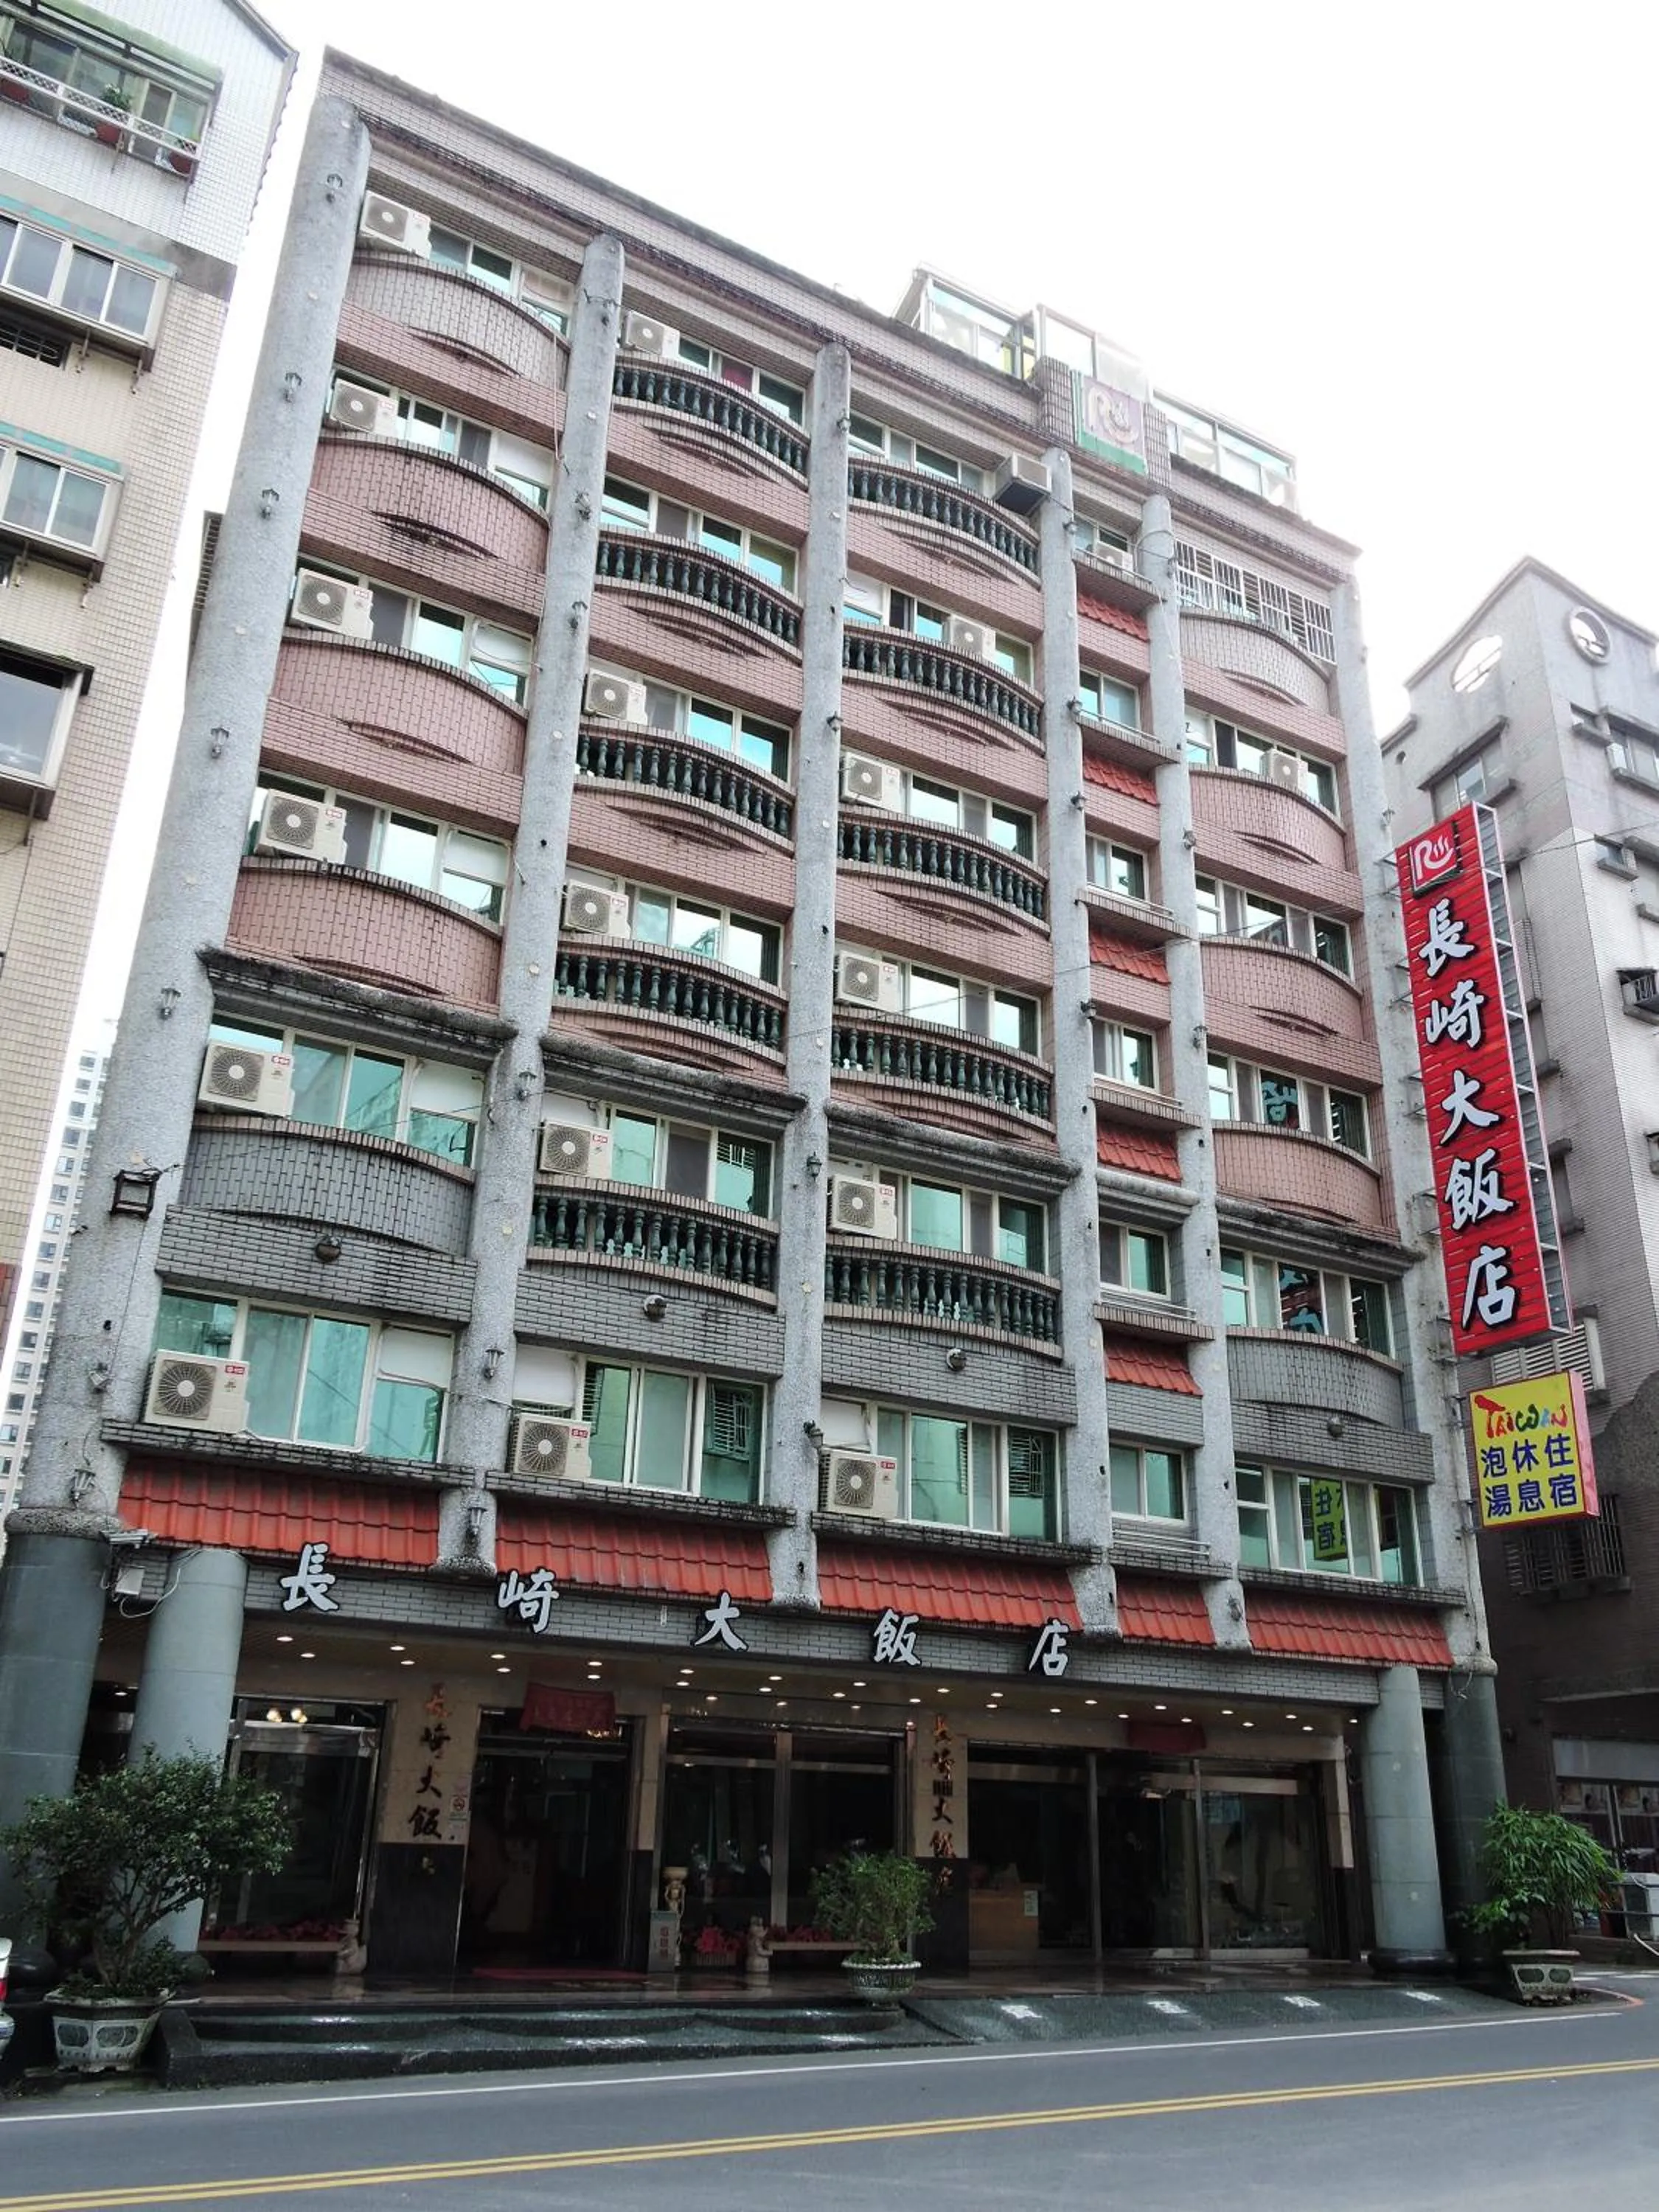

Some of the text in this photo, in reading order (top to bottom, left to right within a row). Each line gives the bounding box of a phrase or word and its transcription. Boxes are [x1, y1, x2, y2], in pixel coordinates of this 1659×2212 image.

[1419, 897, 1515, 1329] 長崎大飯店
[1481, 1446, 1512, 1518] 泡湯
[1512, 1439, 1545, 1512] 休息
[1544, 1433, 1577, 1509] 住宿
[279, 1542, 1069, 1677] 長崎大飯店
